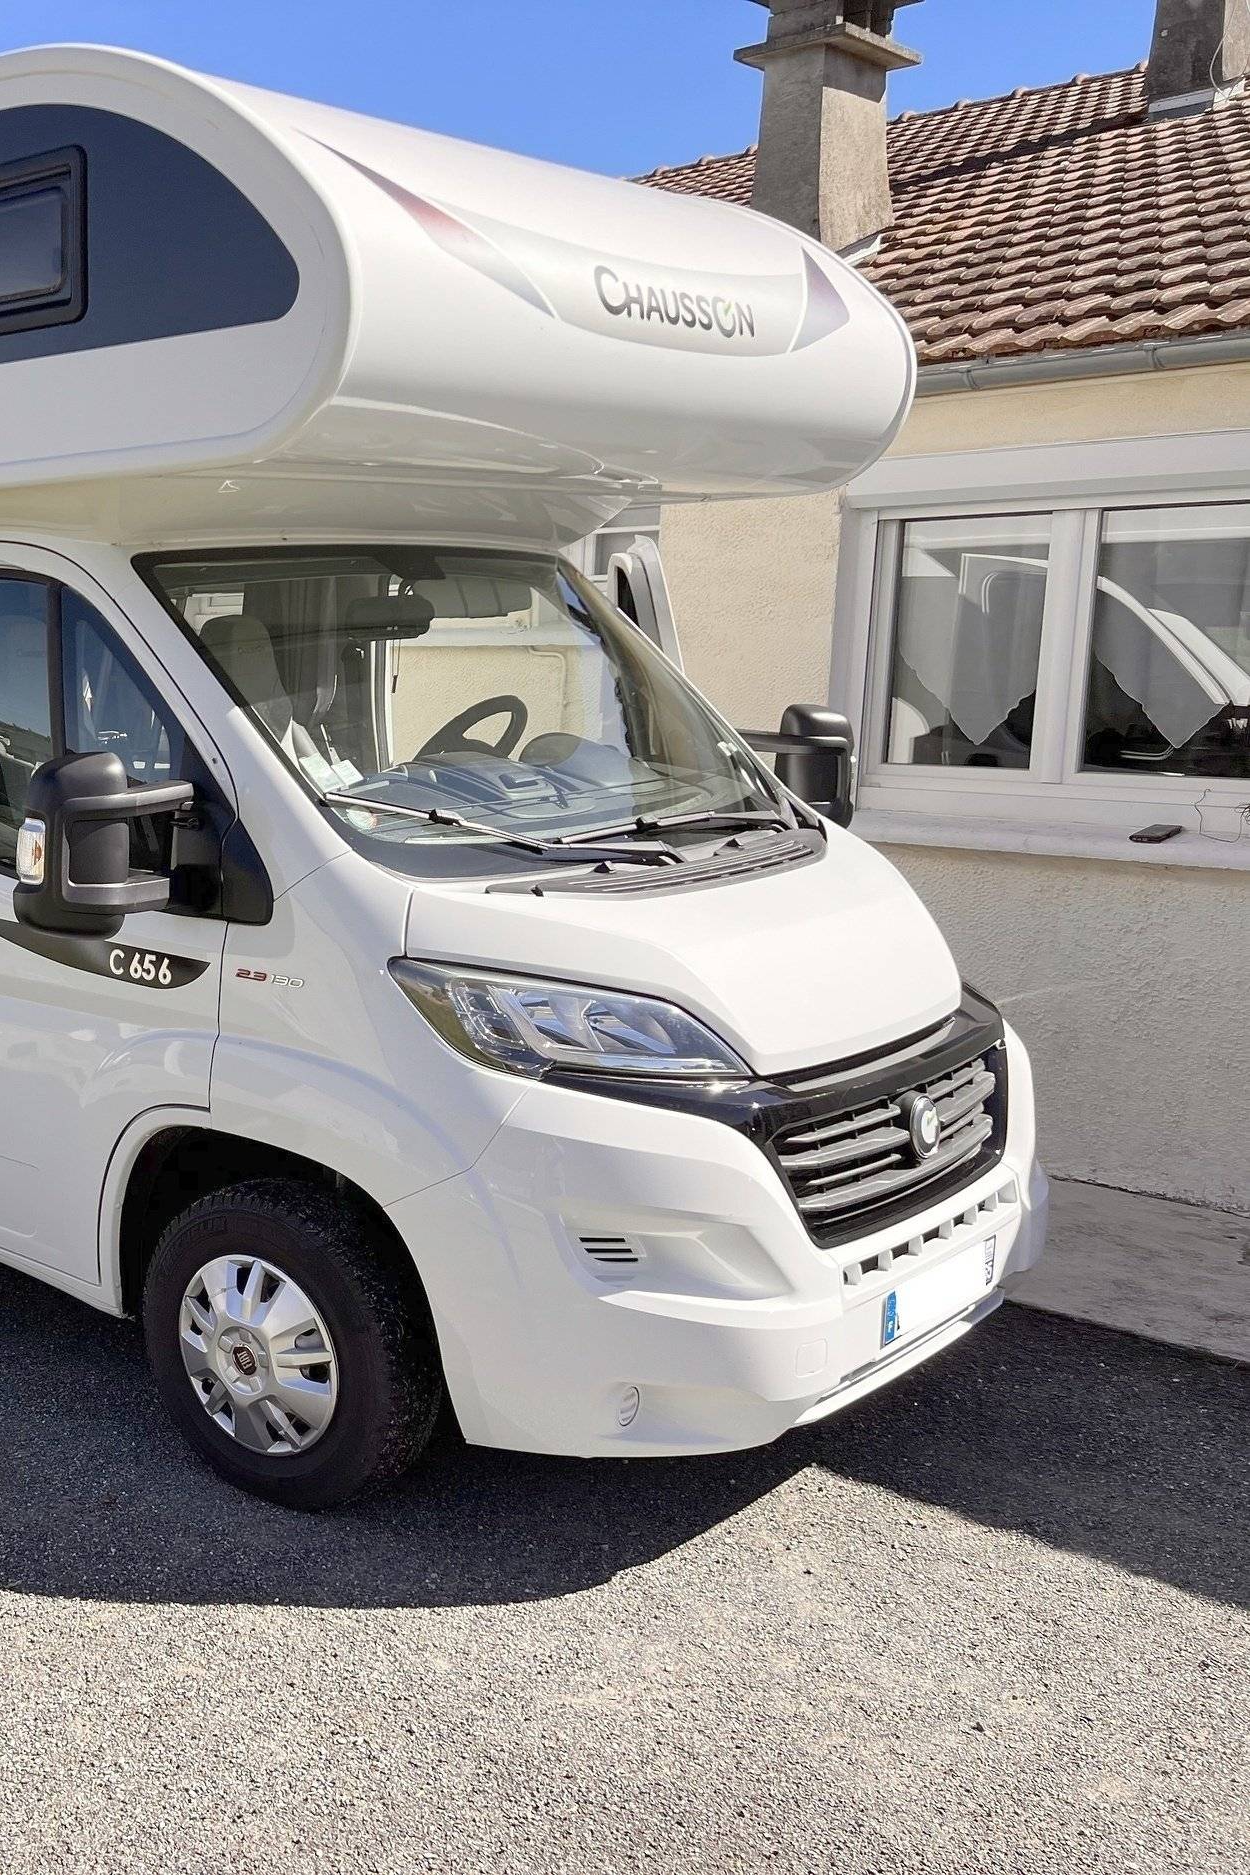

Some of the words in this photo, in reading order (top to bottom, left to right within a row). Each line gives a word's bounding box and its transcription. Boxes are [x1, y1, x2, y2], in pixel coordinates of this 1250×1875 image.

[594, 265, 755, 338] CHAUSSON
[109, 948, 125, 975] C
[129, 951, 172, 985] 656
